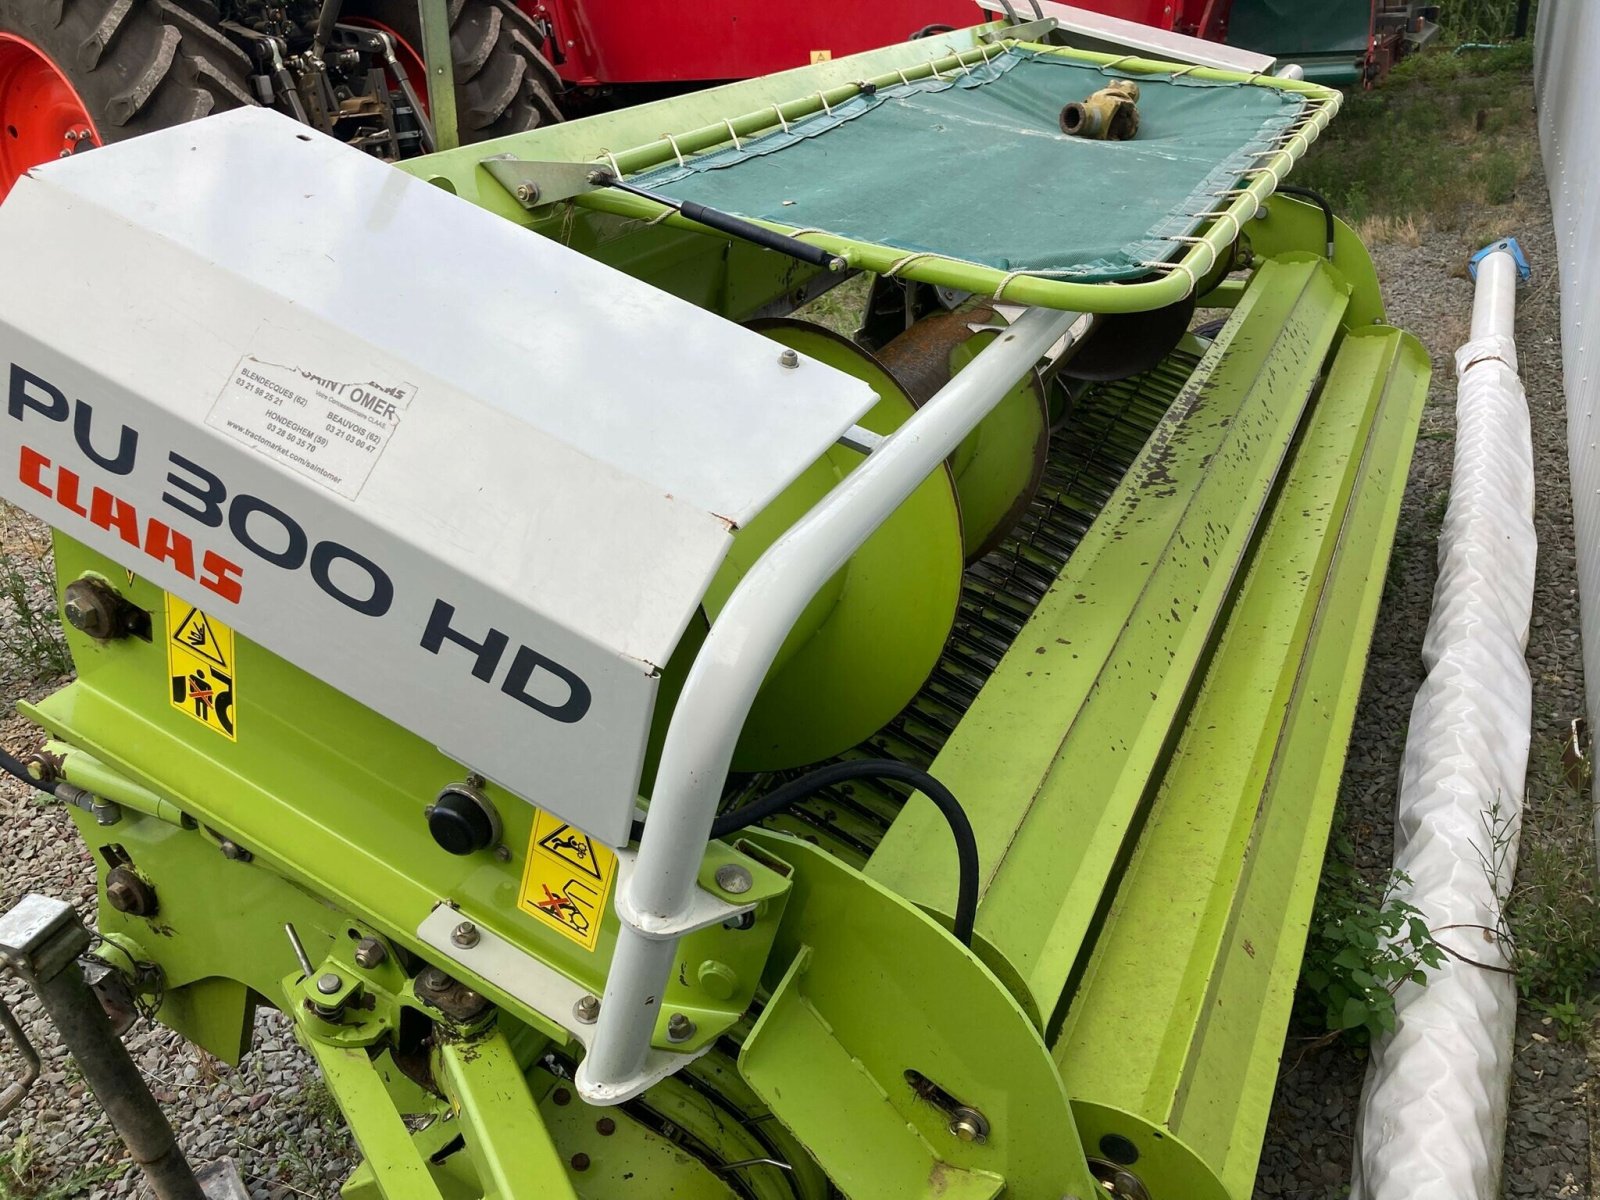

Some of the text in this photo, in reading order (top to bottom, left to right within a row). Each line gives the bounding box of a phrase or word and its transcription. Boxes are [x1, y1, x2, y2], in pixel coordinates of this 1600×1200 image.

[236, 378, 246, 387] 03
[246, 383, 255, 392] 21
[265, 393, 274, 402] 25
[274, 398, 284, 407] 21
[242, 368, 308, 408] BLENDECQUES (62)
[350, 388, 396, 420] OMER
[266, 410, 329, 449] HONDEGHEM (59)
[267, 423, 316, 453] 03 28 50 35 70
[326, 424, 336, 434] 03
[336, 429, 346, 439] 21
[346, 435, 356, 444] 03
[366, 445, 376, 454] 47
[327, 412, 382, 446] BEAUVOIS (62)
[227, 420, 343, 485] www.tractomarket.com/saintomer
[18, 444, 243, 605] CLAAS
[7, 362, 592, 724] PU 300 HD
